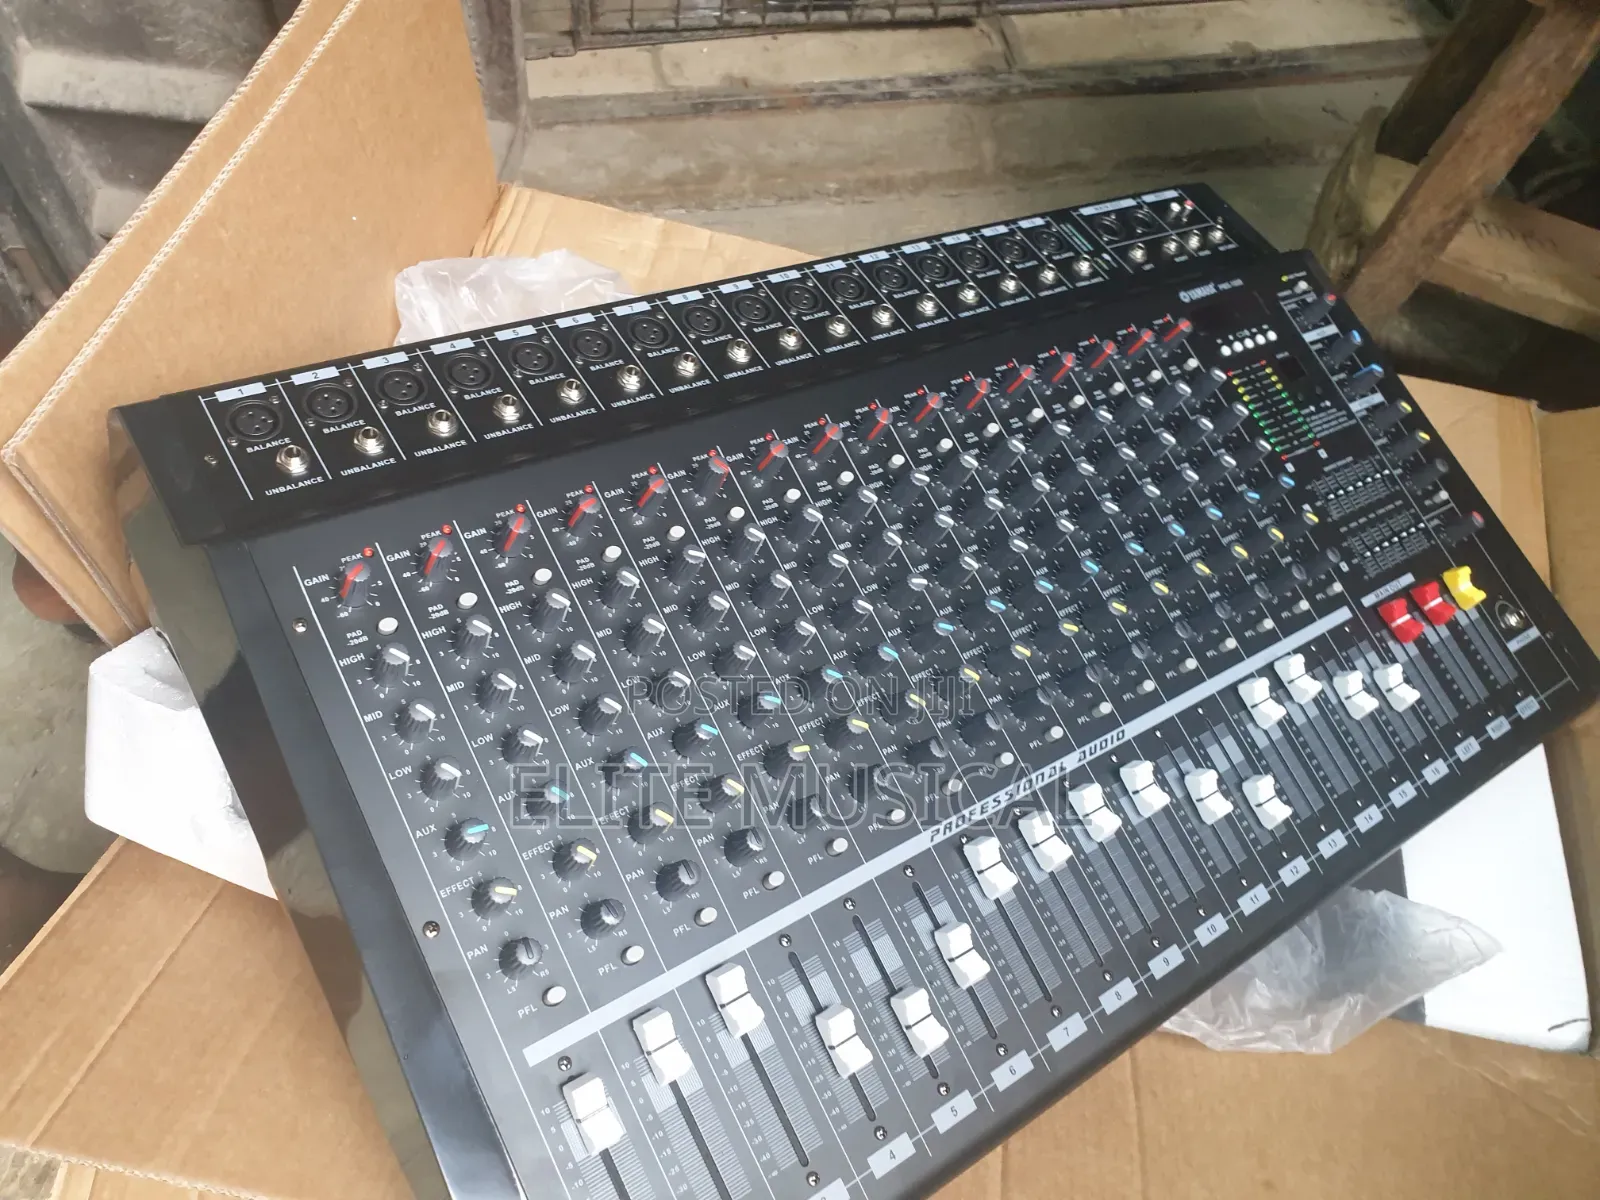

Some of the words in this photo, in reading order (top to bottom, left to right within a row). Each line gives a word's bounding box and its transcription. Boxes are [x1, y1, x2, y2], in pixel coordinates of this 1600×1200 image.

[801, 310, 832, 321] BALANCE
[753, 322, 783, 333] BALANCE
[701, 333, 733, 345] BALANCE
[647, 346, 680, 358] BALANCE
[824, 340, 861, 354] UNBALANCE
[589, 359, 624, 371] BALANCE
[775, 352, 814, 366] UNBALANCE
[723, 365, 763, 380] UNBALANCE
[529, 373, 566, 385] BALANCE
[669, 378, 710, 394] UNBALANCE
[464, 387, 503, 400] BALANCE
[611, 393, 656, 409] UNBALANCE
[395, 403, 436, 417] BALANCE
[550, 407, 598, 424] UNBALANCE
[323, 419, 366, 434] BALANCE
[484, 423, 534, 440] UNBALANCE
[246, 437, 291, 453] BALANCE
[749, 437, 766, 446] PEAK
[414, 440, 467, 458] UNBALANCE
[692, 453, 710, 462] PEAK
[726, 452, 745, 463] GAIN
[341, 458, 396, 477] UNBALANCE
[631, 471, 649, 480] PEAK
[667, 469, 687, 481] GAIN
[266, 476, 324, 496] UNBALANCE
[566, 488, 585, 499] PEAK
[604, 487, 625, 499] GAIN
[815, 498, 832, 508] HIGH
[495, 508, 515, 519] PEAK
[536, 507, 558, 519] GAIN
[704, 516, 717, 525] PAD
[759, 516, 778, 527] HIGH
[421, 530, 442, 541] PEAK
[464, 527, 487, 539] GAIN
[643, 535, 656, 544] PAD
[701, 535, 721, 546] HIGH
[838, 542, 852, 550] MID
[964, 544, 979, 553] LOW
[340, 552, 363, 564] PEAK
[386, 550, 411, 562] GAIN
[575, 556, 590, 565] PAD
[638, 555, 660, 567] HIGH
[783, 561, 798, 570] MID
[914, 563, 930, 573] LOW
[304, 574, 330, 587] GAIN
[504, 579, 519, 588] PAD
[571, 578, 594, 589] HIGH
[725, 582, 740, 592] MID
[862, 583, 879, 593] LOW
[988, 585, 1002, 595] AUX
[428, 603, 444, 613] PAD
[498, 601, 522, 614] HIGH
[662, 604, 679, 615] MID
[808, 604, 825, 615] LOW
[939, 606, 953, 616] AUX
[346, 629, 363, 639] PAD
[421, 626, 447, 640] HIGH
[596, 627, 613, 639] MID
[749, 626, 767, 638] LOW
[887, 627, 903, 637] AUX
[1011, 624, 1033, 638] EFFECT
[687, 650, 706, 662] LOW
[832, 650, 849, 661] AUX
[962, 645, 984, 660] EFFECT
[1084, 651, 1097, 659] PAN
[339, 653, 366, 668] HIGH
[524, 653, 542, 665] MID
[774, 673, 791, 685] AUX
[910, 668, 933, 683] EFFECT
[1037, 671, 1051, 681] PAN
[446, 681, 465, 693] MID
[621, 675, 641, 689] LOW
[856, 691, 881, 707] EFFECT
[988, 694, 1003, 704] PAN
[1122, 692, 1135, 701] PFL
[549, 704, 570, 717] LOW
[713, 699, 731, 712] AUX
[363, 710, 383, 723] MID
[1077, 716, 1090, 725] PFL
[798, 717, 824, 733] EFFECT
[937, 719, 951, 729] PAN
[646, 726, 666, 740] AUX
[471, 733, 494, 748] LOW
[1028, 740, 1043, 750] PFL
[736, 744, 764, 762] EFFECT
[882, 744, 898, 755] PAN
[574, 757, 595, 771] AUX
[388, 765, 412, 780] LOW
[978, 766, 993, 775] PFL
[670, 774, 700, 792] EFFECT
[824, 771, 841, 783] PAN
[930, 763, 1067, 843] PROFESSIONAL
[1078, 729, 1126, 763] AUDIO
[498, 790, 519, 804] AUX
[924, 792, 939, 803] PFL
[762, 801, 779, 812] PAN
[598, 805, 631, 825] EFFECT
[415, 824, 437, 838] AUX
[867, 822, 884, 833] PFL
[697, 833, 715, 847] PAN
[522, 840, 555, 860] EFFECT
[807, 853, 824, 865] PFL
[625, 868, 645, 882] PAN
[439, 877, 475, 899] EFFECT
[743, 887, 760, 899] PFL
[549, 905, 570, 920] PAN
[673, 923, 692, 937] PFL
[467, 944, 489, 960] PAN
[598, 962, 618, 976] PFL
[517, 1004, 538, 1019] PFL
